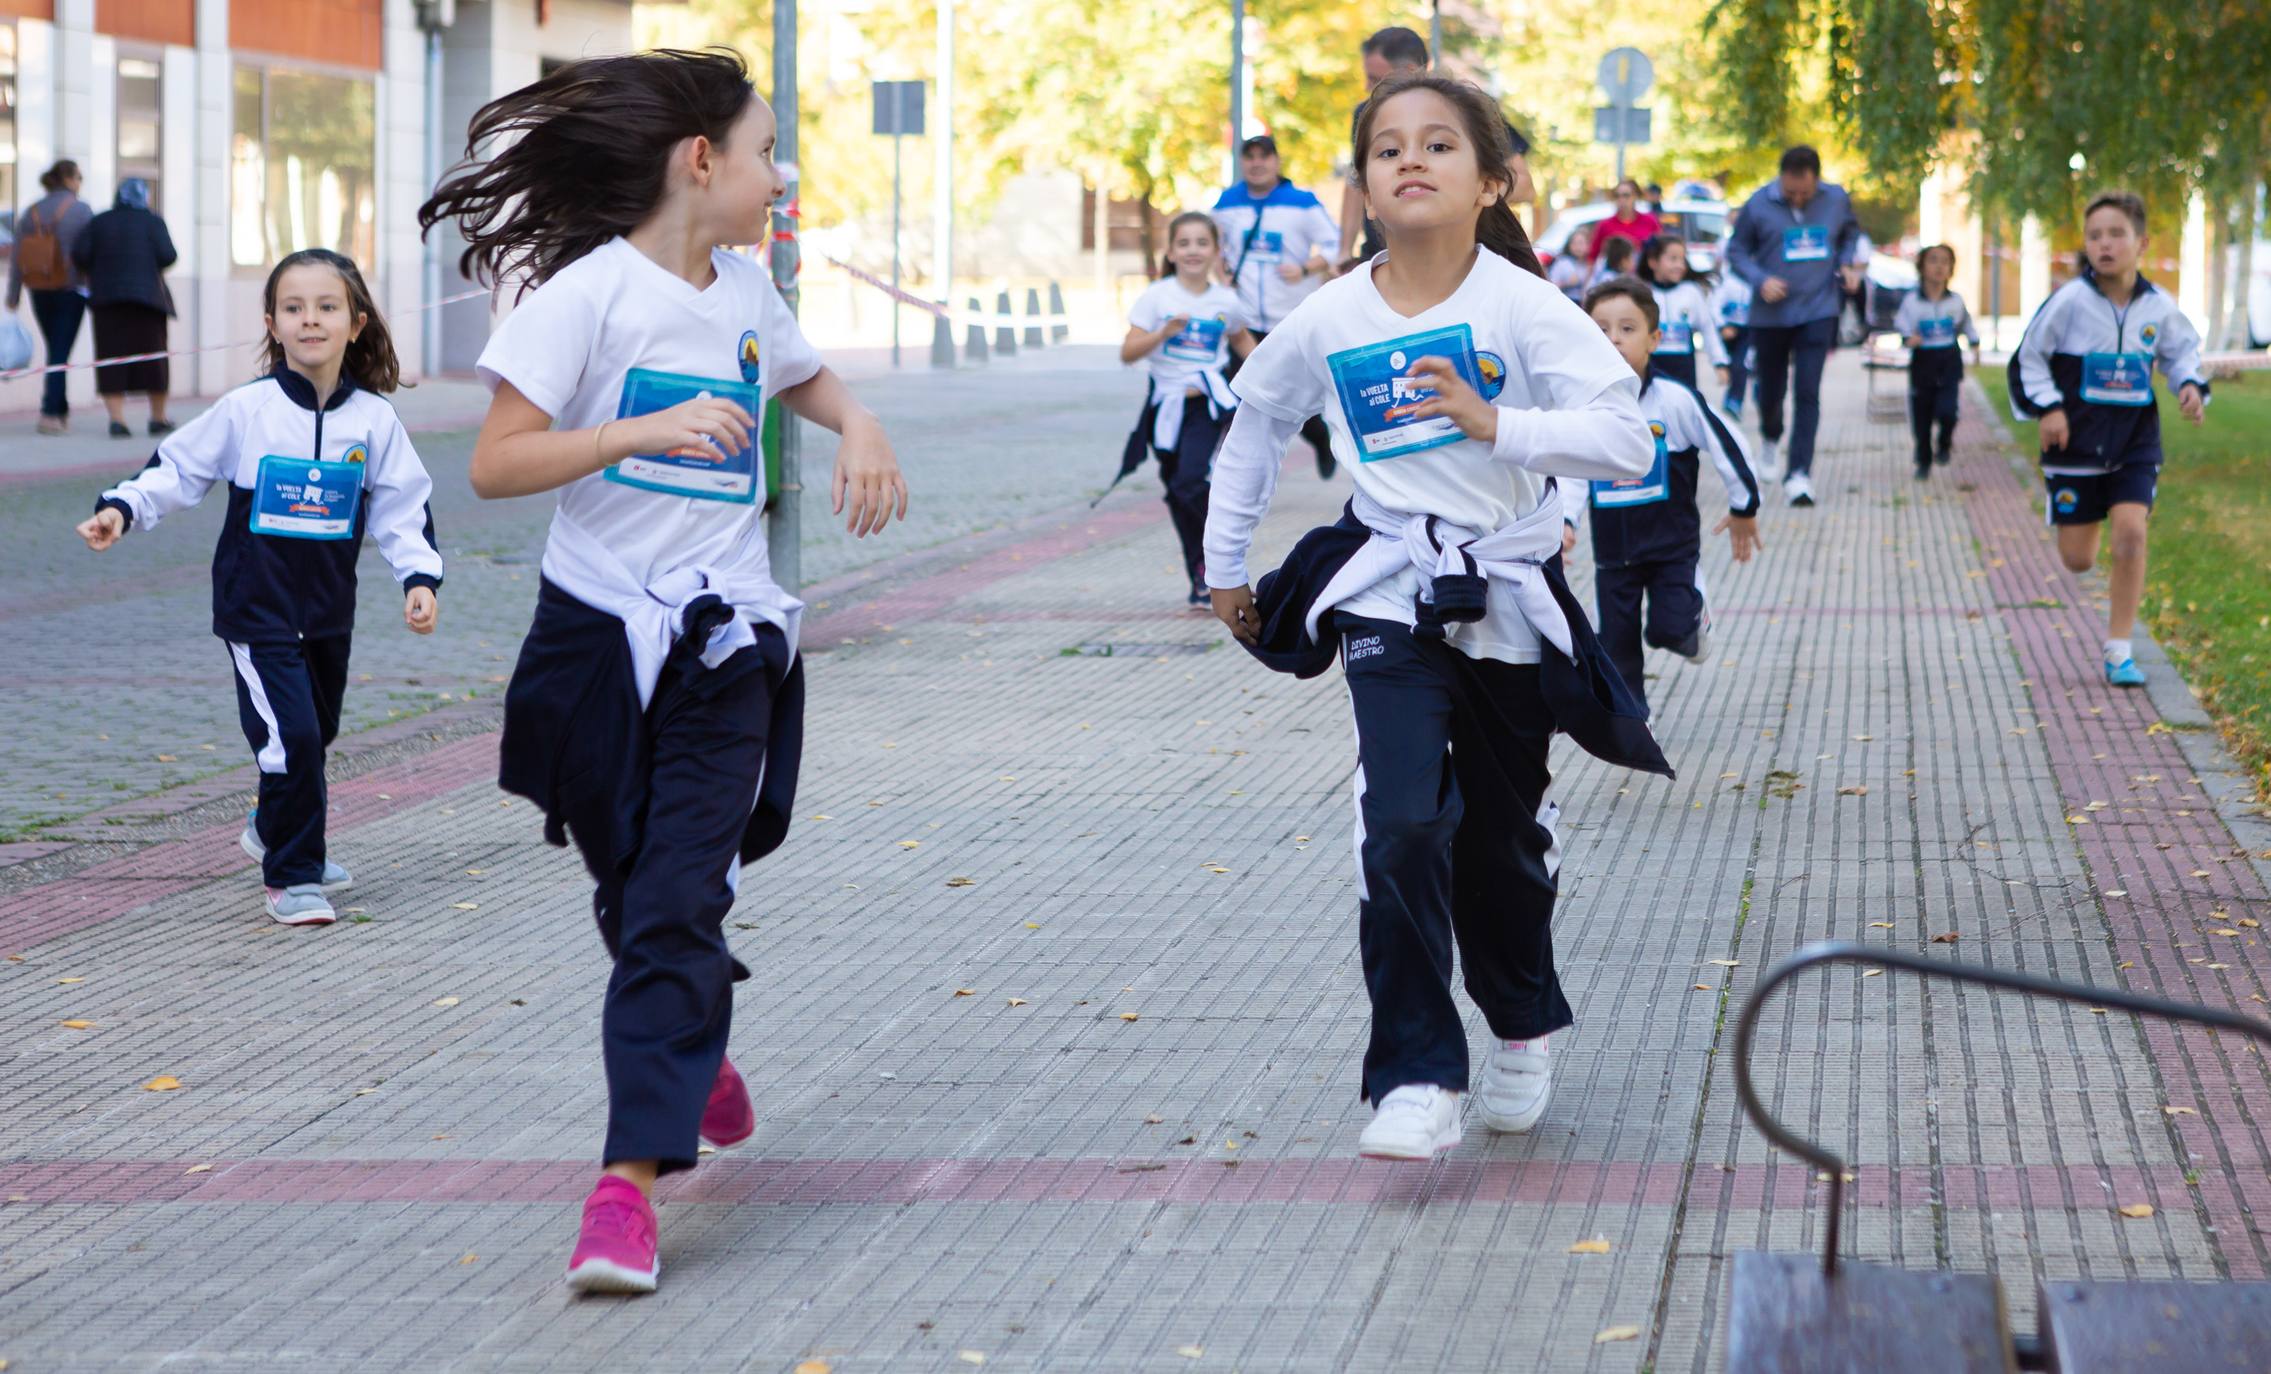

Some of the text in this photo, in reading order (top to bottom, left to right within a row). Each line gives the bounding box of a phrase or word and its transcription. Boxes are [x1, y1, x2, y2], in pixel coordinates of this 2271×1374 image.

[1366, 383, 1389, 396] VUELTA
[1375, 393, 1391, 405] COLE
[1351, 636, 1381, 650] DIVINO
